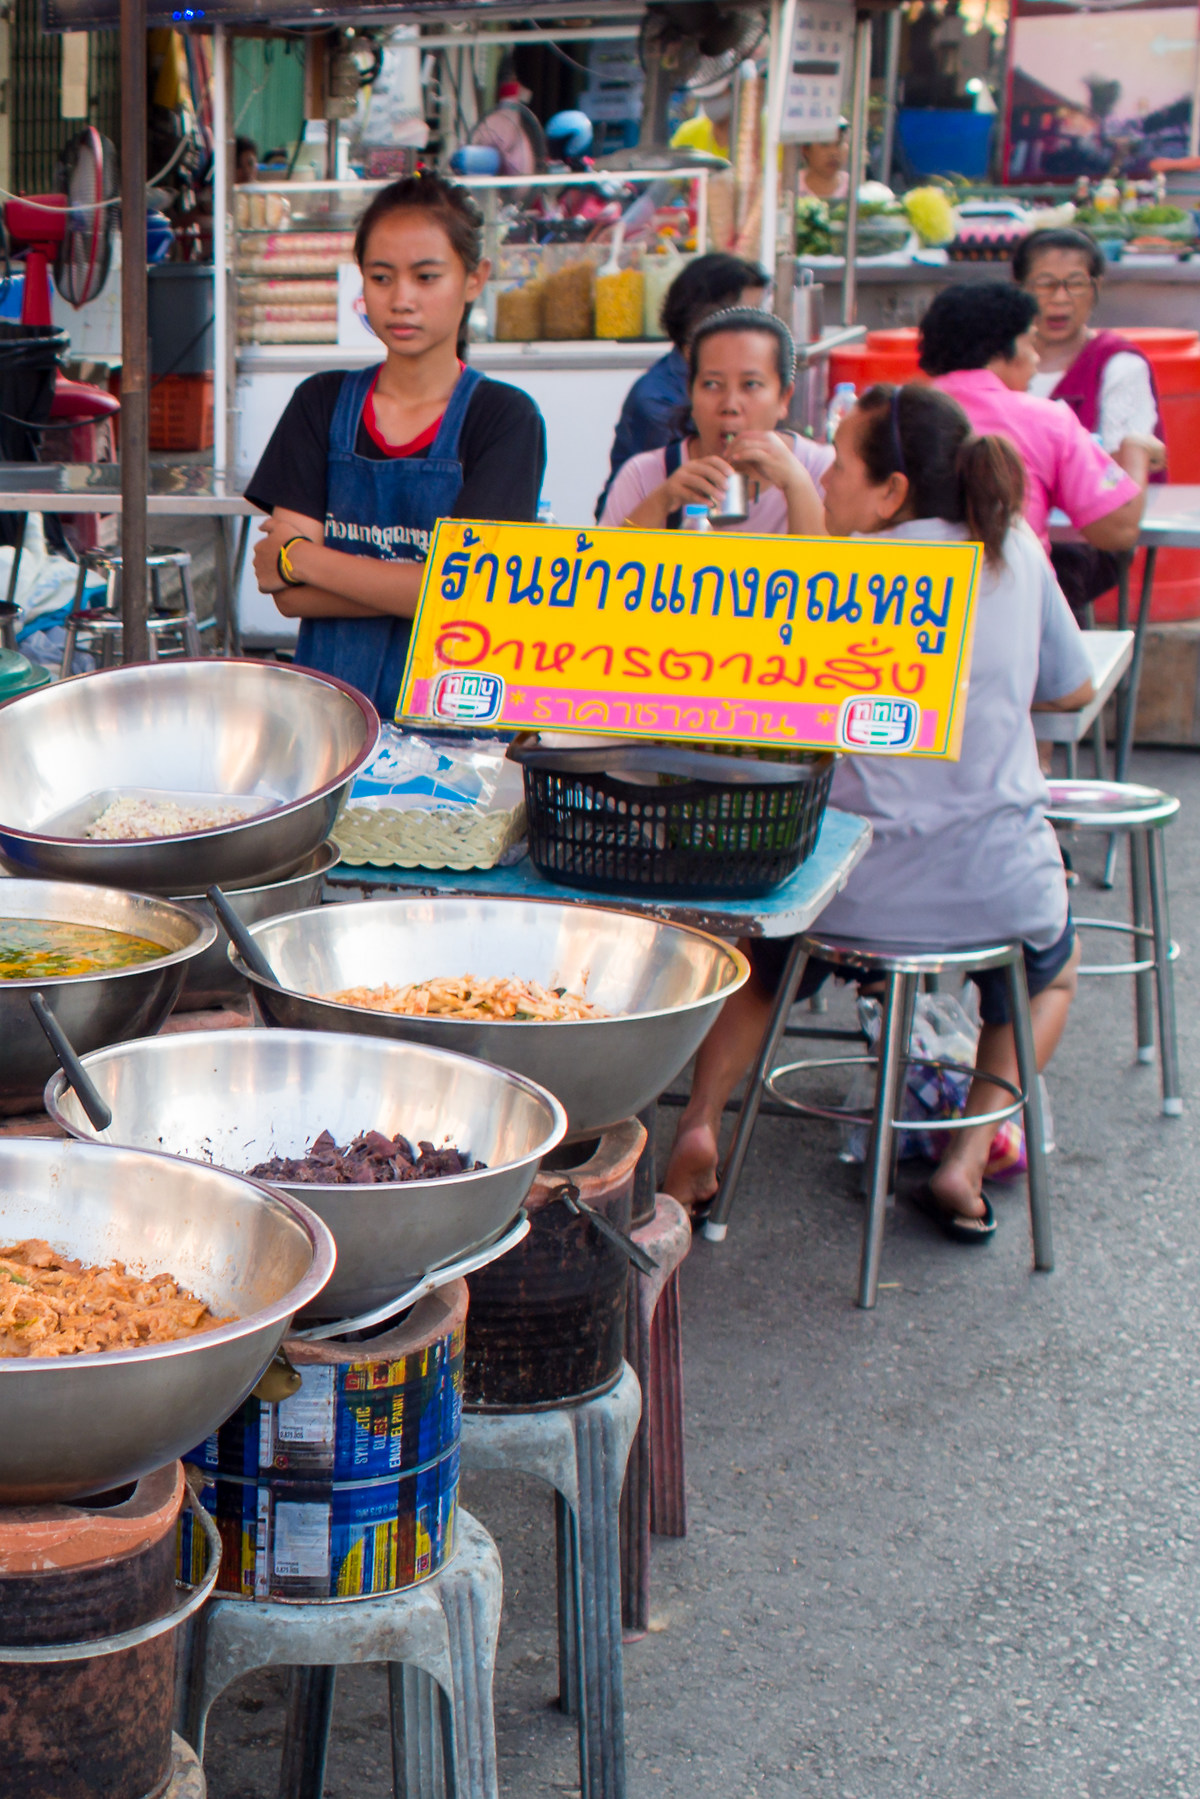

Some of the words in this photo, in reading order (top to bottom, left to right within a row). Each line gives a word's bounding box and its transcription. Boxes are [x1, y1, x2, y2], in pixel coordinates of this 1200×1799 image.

[440, 527, 955, 655] ร้านข้าวแกงคุณหมู
[434, 619, 927, 695] อาหารตามสั่ง
[532, 696, 798, 737] ราคาชาวบ้าน
[354, 1405, 372, 1465] SYNTHETIC
[389, 1424, 404, 1468] ENAMEL
